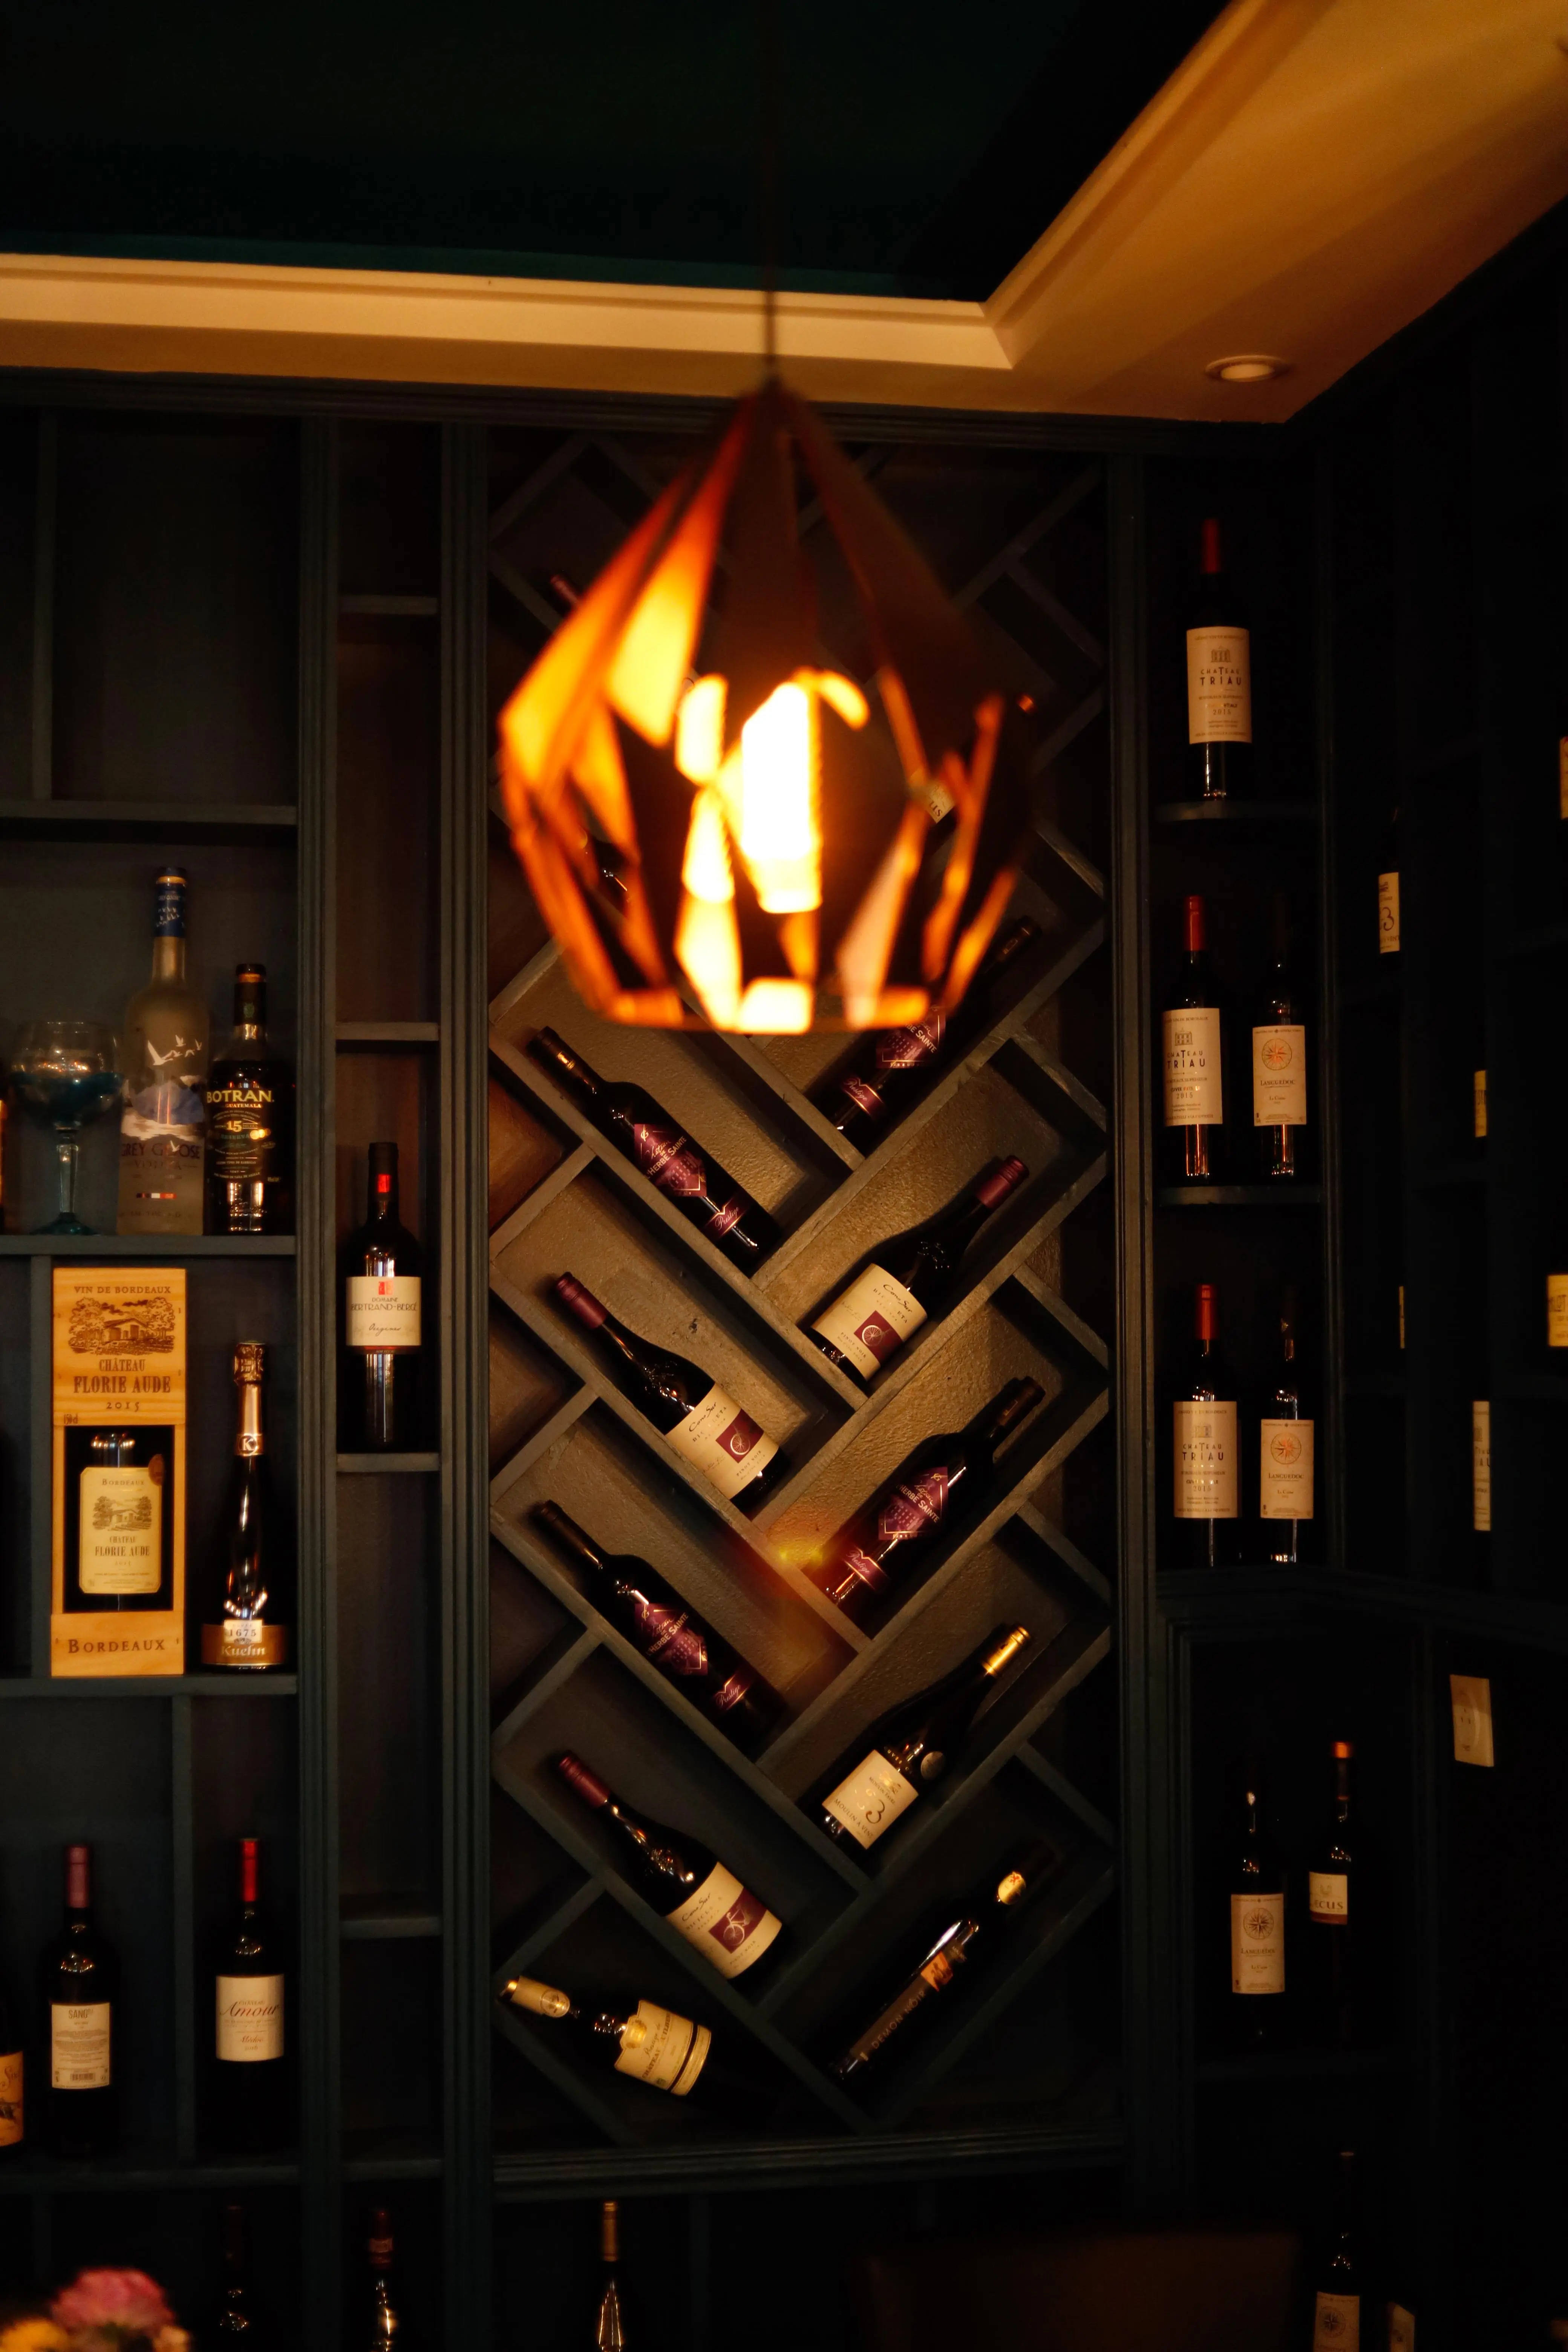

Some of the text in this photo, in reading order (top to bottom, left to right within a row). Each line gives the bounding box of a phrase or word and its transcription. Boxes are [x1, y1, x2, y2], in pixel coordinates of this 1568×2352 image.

[1200, 677, 1241, 686] TRIAU
[916, 1030, 937, 1054] SAINTE
[1167, 1058, 1205, 1069] TRIAU
[207, 1090, 272, 1103] BOTRAN
[226, 1120, 242, 1132] 15
[668, 1136, 687, 1156] SAINTE
[99, 1358, 145, 1372] CHÂTEAU
[74, 1376, 171, 1393] FLORIE AUDE
[106, 1402, 140, 1412] 2015
[1182, 1452, 1223, 1461] TRIAU
[918, 1499, 940, 1523] SAINTE
[95, 1546, 150, 1557] FLORIE AUDE
[668, 1612, 689, 1635] SAINTE
[68, 1638, 165, 1653] BORDEAUX
[834, 1798, 857, 1821] MOULIN
[220, 2001, 279, 2017] Amour
[871, 1990, 926, 2049] DEMON NOIR
